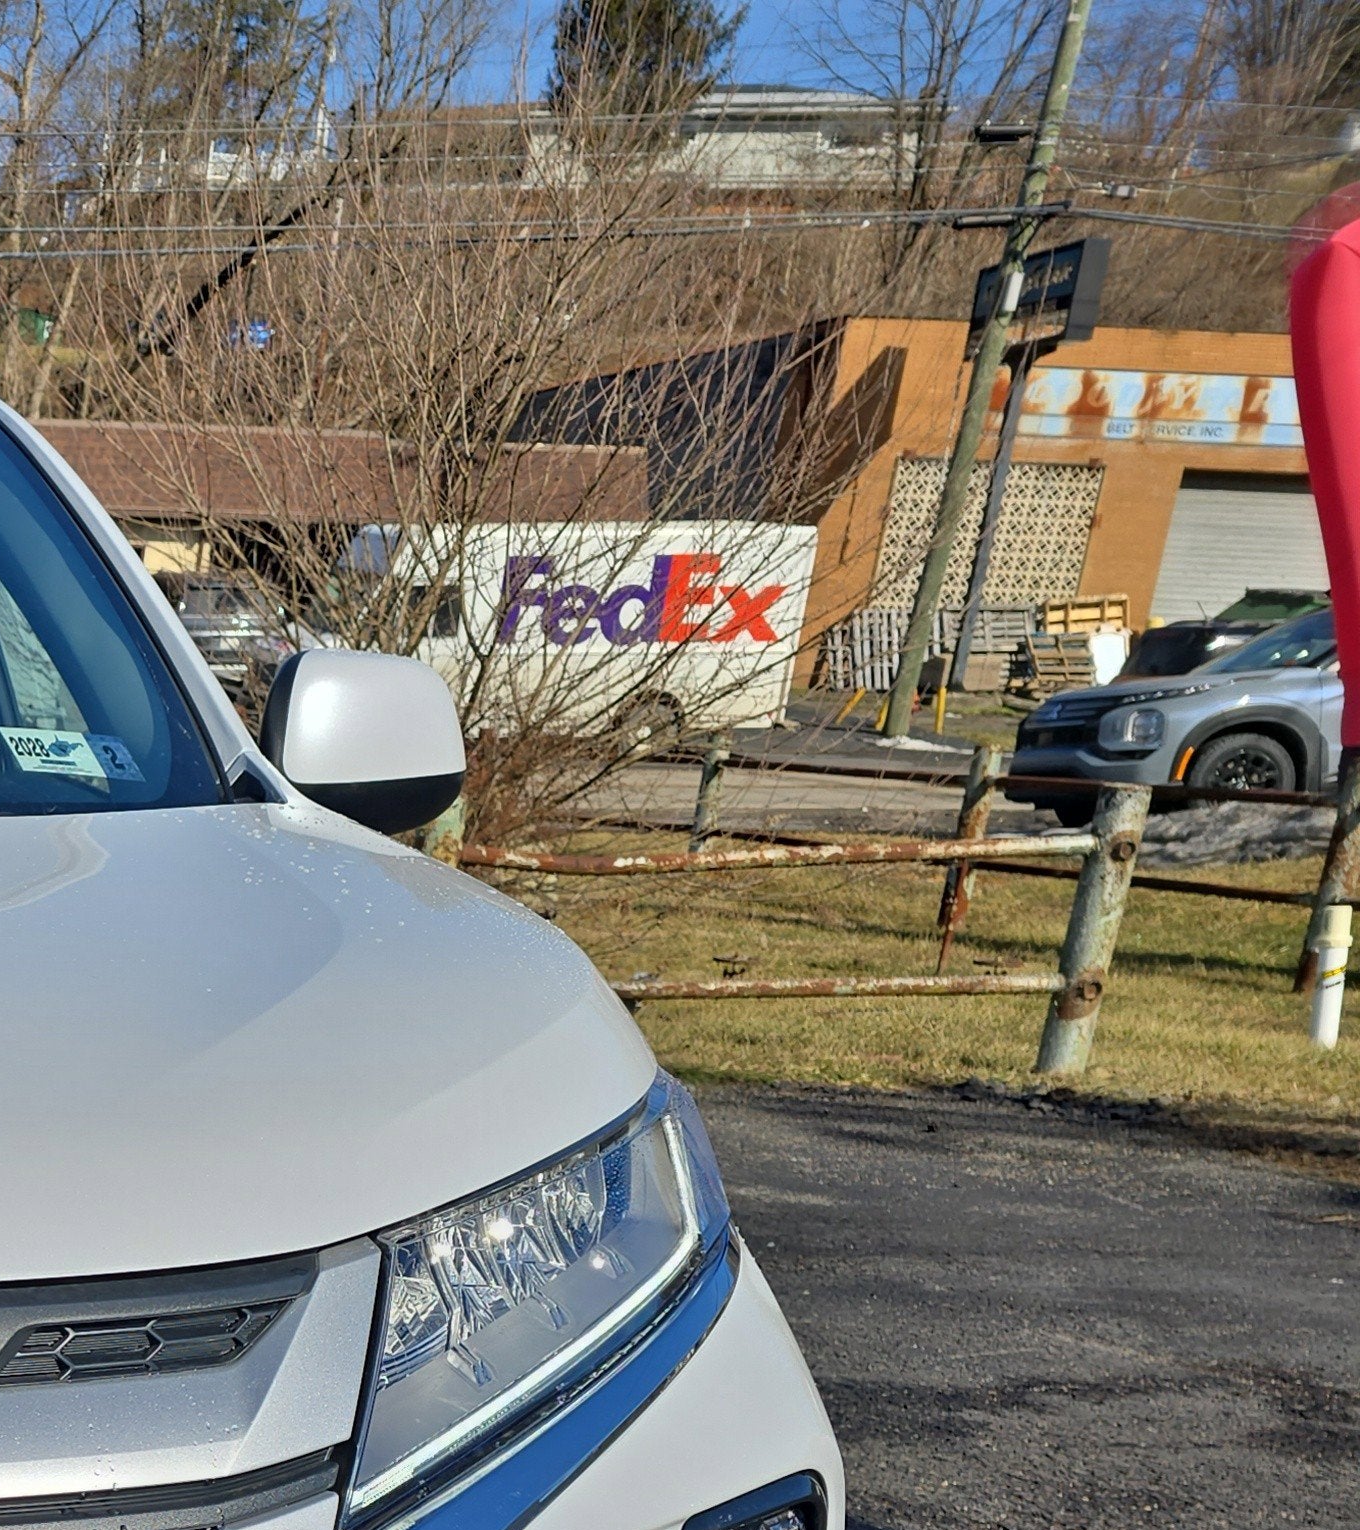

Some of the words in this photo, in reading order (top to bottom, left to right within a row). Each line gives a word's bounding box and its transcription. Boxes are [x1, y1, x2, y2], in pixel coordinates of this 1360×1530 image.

[497, 553, 790, 645] FedEx
[9, 736, 50, 758] 2028
[102, 745, 126, 770] 2
